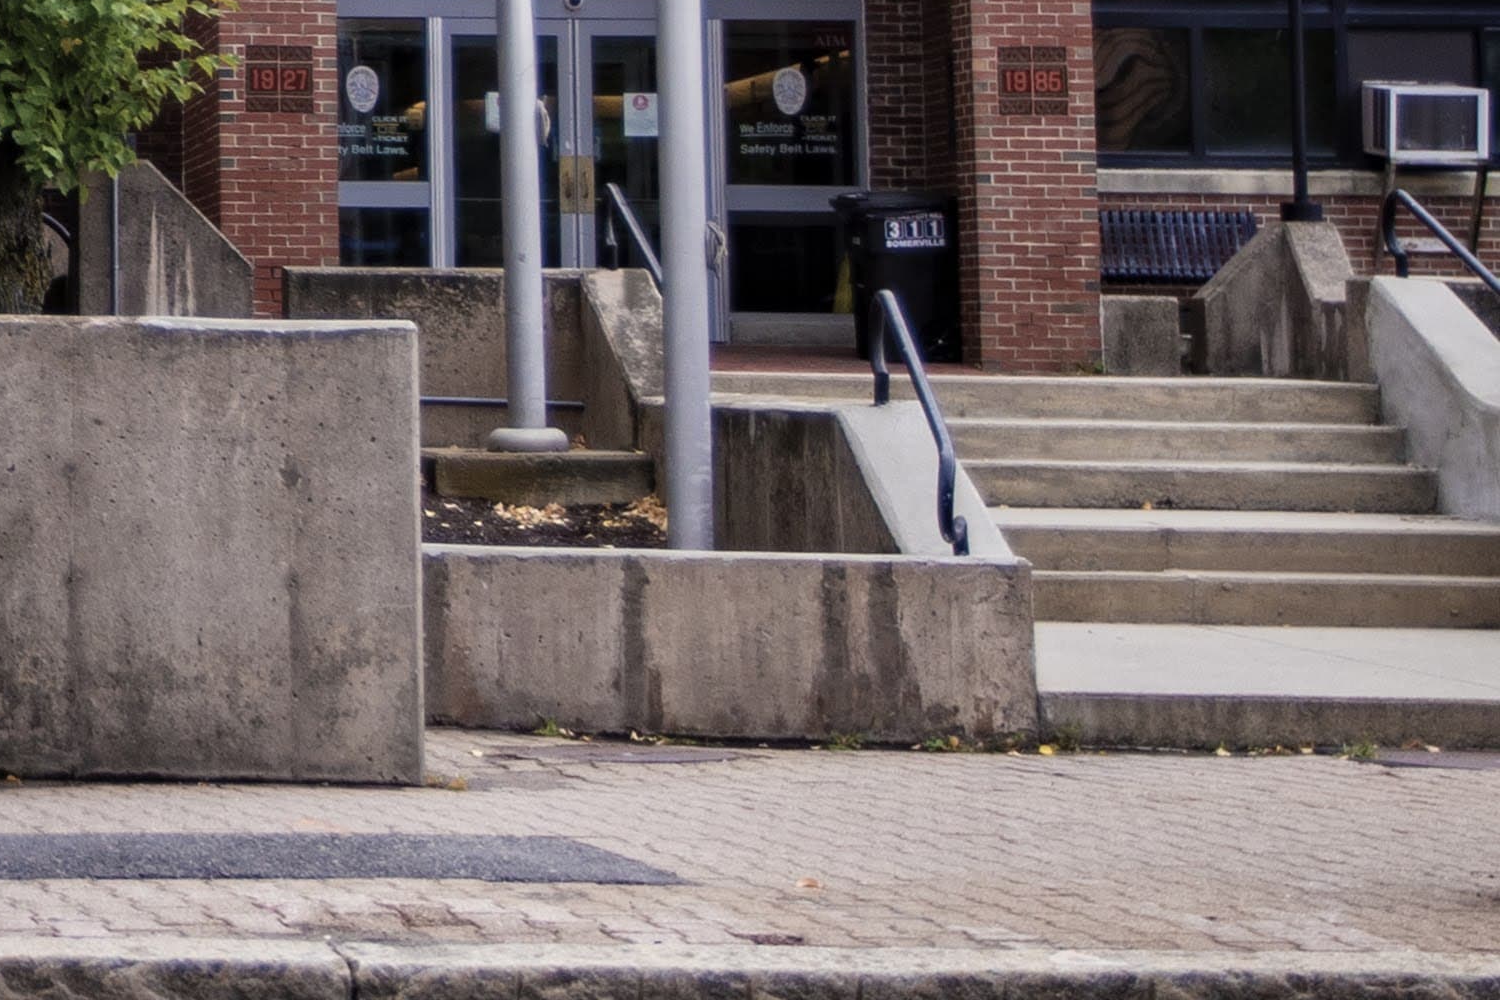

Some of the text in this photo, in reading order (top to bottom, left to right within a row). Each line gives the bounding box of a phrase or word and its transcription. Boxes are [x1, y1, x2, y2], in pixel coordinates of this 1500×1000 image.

[252, 68, 308, 91] 1927
[1006, 70, 1062, 92] 1986
[756, 122, 794, 134] Enforce
[351, 144, 374, 154] Belt
[377, 145, 409, 155] Laws.
[740, 144, 776, 155] Safety
[779, 144, 802, 154] Belt
[886, 240, 945, 248] SOMERVILLE
